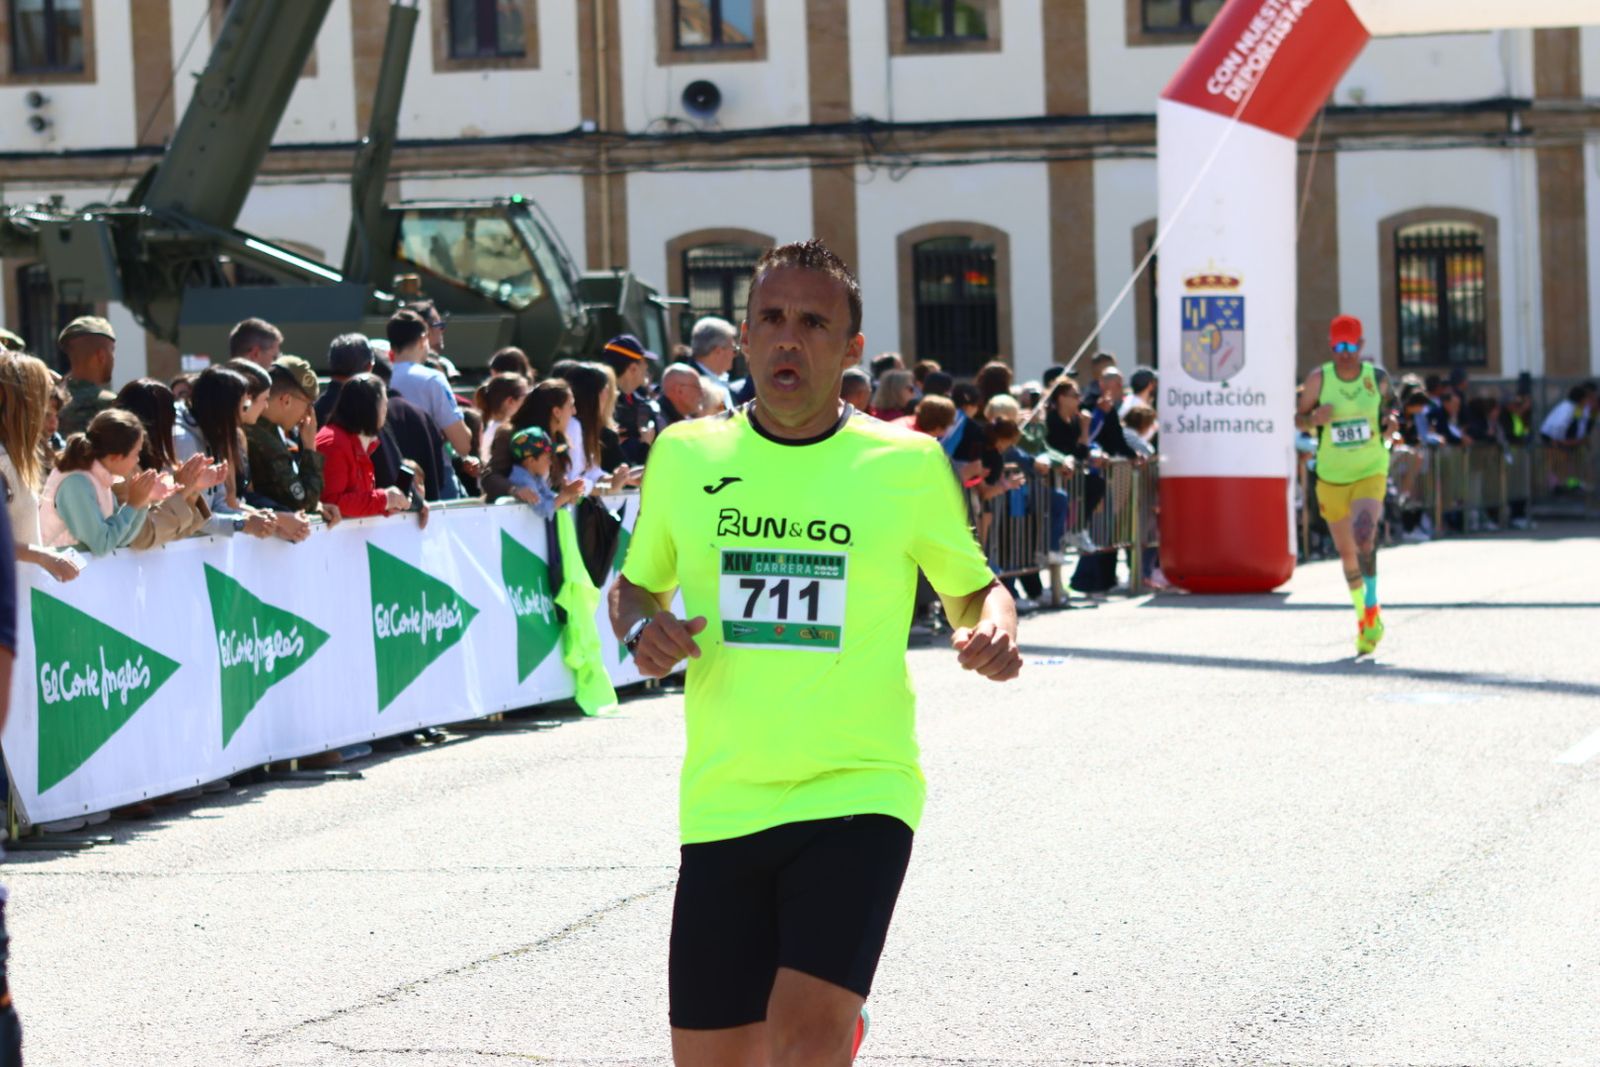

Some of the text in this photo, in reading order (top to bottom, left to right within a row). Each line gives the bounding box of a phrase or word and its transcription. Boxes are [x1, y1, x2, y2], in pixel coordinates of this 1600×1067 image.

[1206, 50, 1244, 95] CON
[1167, 386, 1266, 411] Diputación
[1177, 414, 1274, 434] Salamanca
[1336, 427, 1363, 442] 981
[724, 553, 753, 572] XIV
[755, 562, 812, 575] CARRERA
[739, 577, 820, 622] 711
[374, 591, 463, 646] El Corte Inglés
[219, 616, 304, 676] El Corte Inglés
[40, 645, 151, 711] El Corte Inglés
